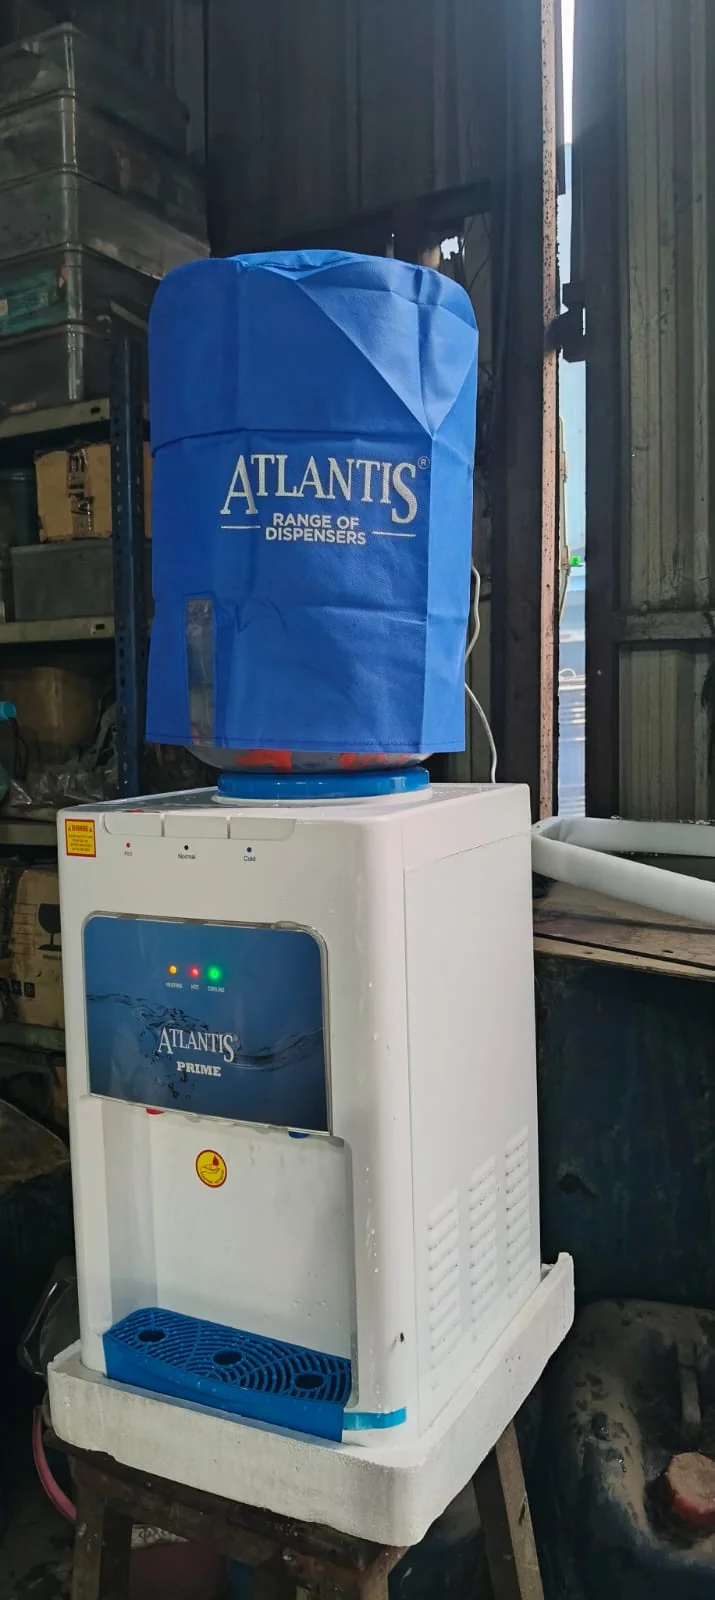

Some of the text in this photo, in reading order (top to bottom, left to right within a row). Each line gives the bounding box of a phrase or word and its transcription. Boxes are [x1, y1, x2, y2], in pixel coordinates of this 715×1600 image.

[219, 454, 418, 524] ATLANTIS
[273, 513, 360, 530] RANGE OF
[265, 527, 366, 545] DISPENSERS
[157, 1026, 235, 1063] ATLANTIS
[176, 1061, 222, 1077] PRIME
